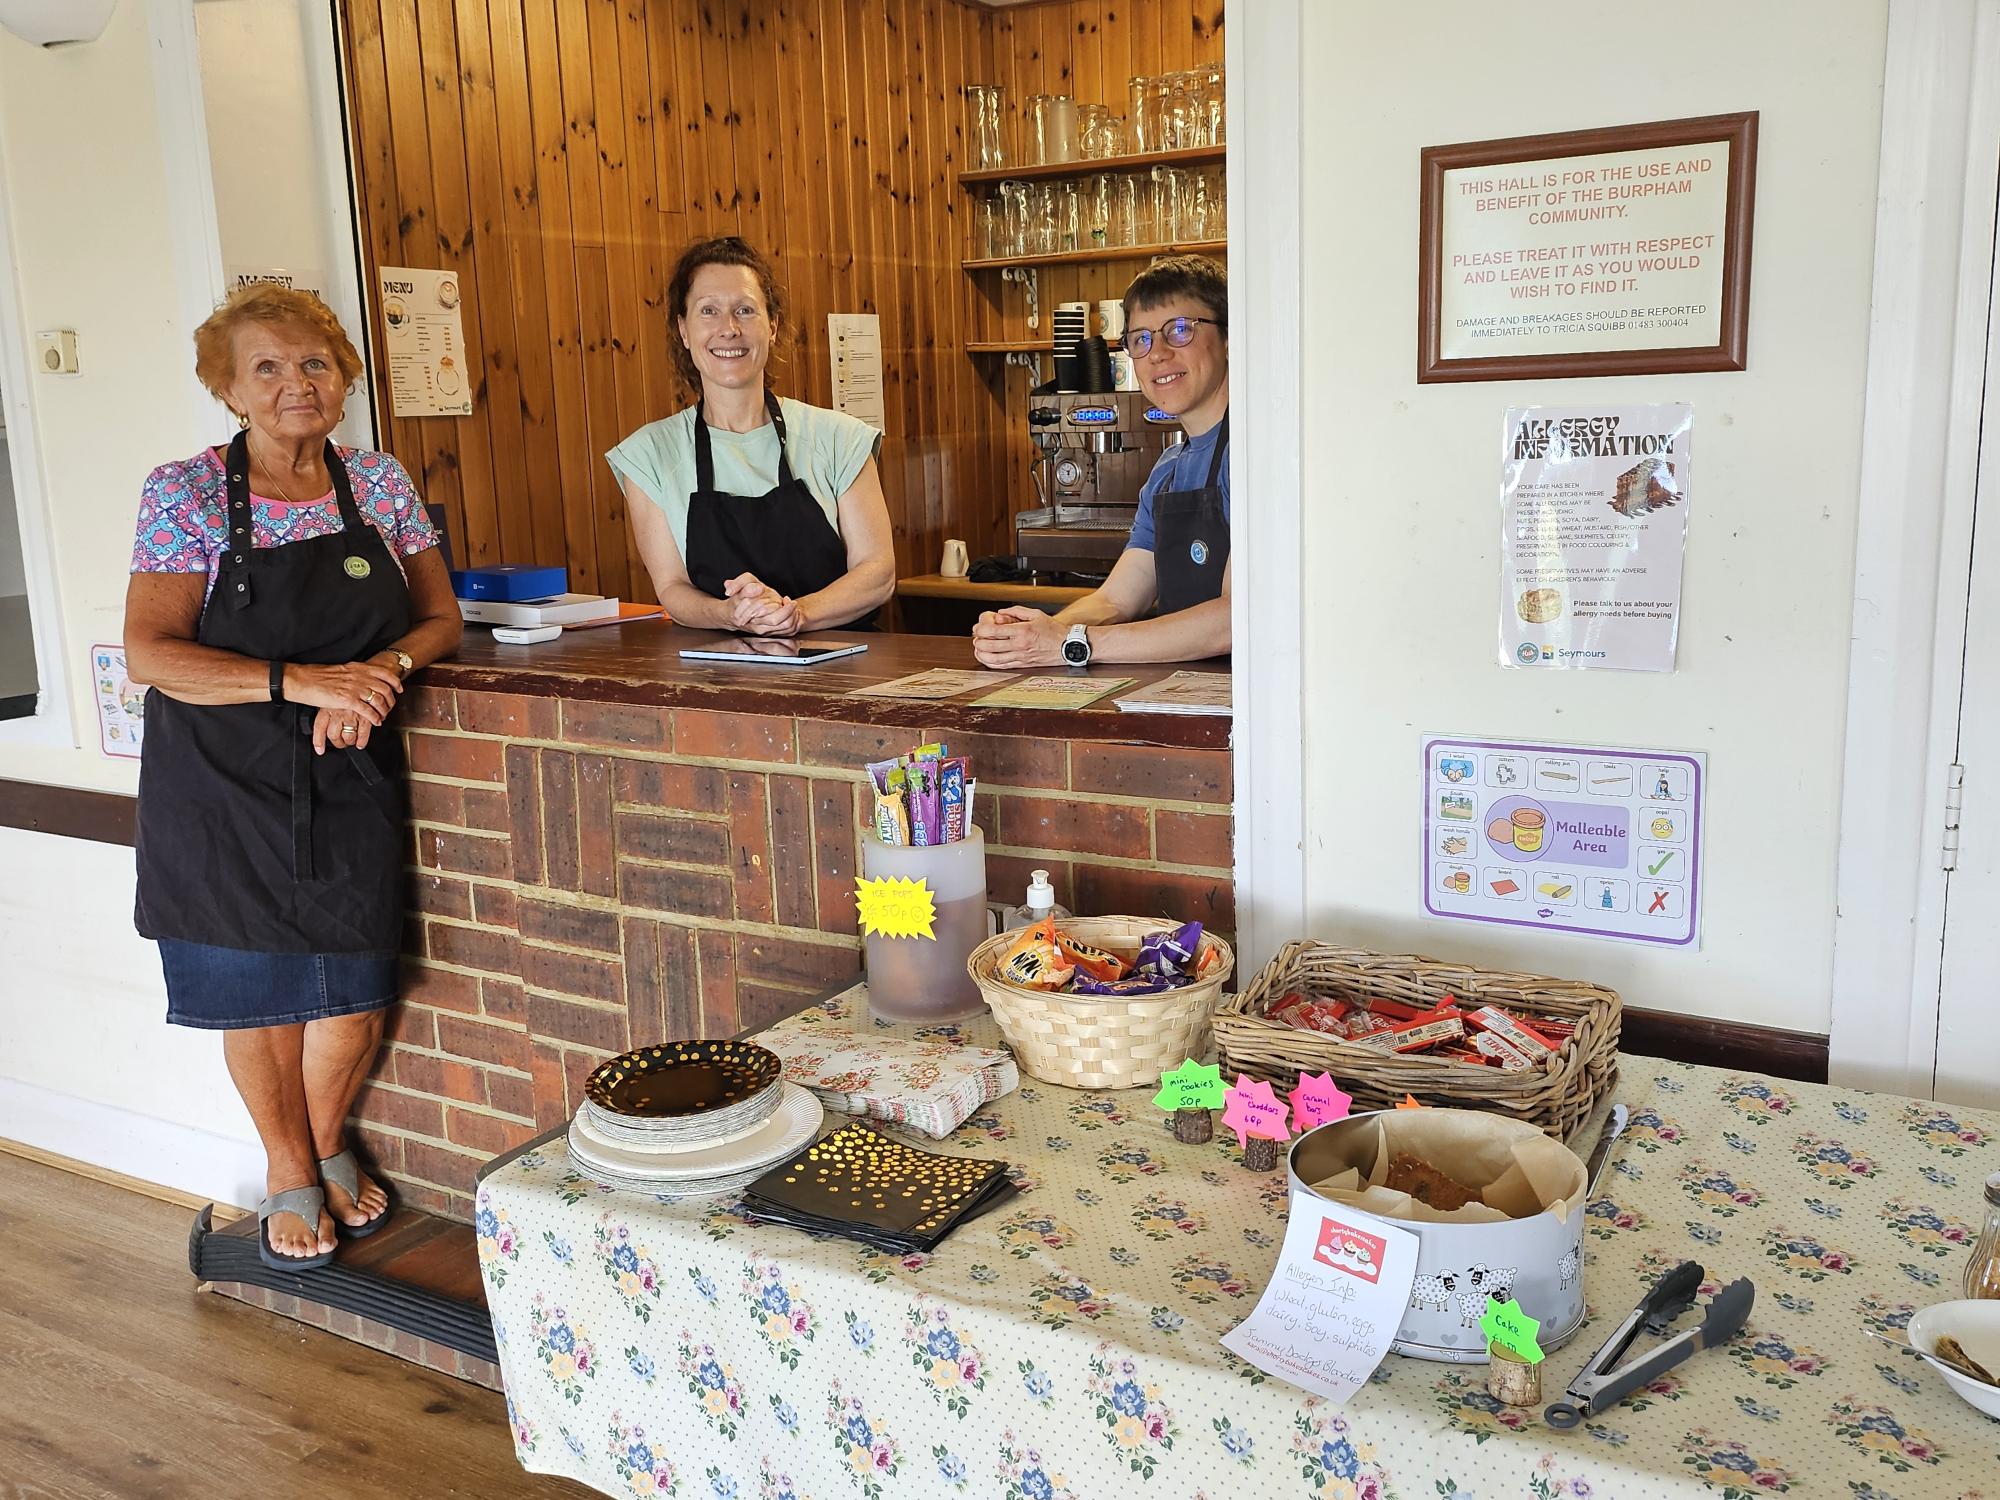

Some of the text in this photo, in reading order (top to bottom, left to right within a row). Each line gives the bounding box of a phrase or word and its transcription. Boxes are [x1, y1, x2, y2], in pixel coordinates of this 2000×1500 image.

[1460, 158, 1712, 196] THIS HALL IS FOR THE USE AND
[1476, 180, 1692, 212] BENEFIT OF THE BURPHAM
[1528, 205, 1628, 225] COMMUNITY.
[1453, 235, 1716, 267] PLEASE TREAT IT WITH RESPECT
[1463, 255, 1701, 285] AND LEAVE IT AS YOU WOULD
[383, 281, 414, 295] MENU
[1510, 278, 1639, 299] WISH TO FIND IT.
[1456, 304, 1707, 328] DAMAGE AND BREAKAGES SHOULD BE REPORTED
[1471, 318, 1689, 338] IMMEDIATELY TO TRICIA SQUIBB 01483 300404
[1514, 416, 1620, 440] ALLERGY
[1573, 600, 1598, 608] Please
[1599, 600, 1613, 608] talk
[1633, 600, 1655, 608] about
[1656, 601, 1673, 611] your
[1573, 610, 1598, 619] allergy
[1623, 610, 1646, 618] before
[1647, 611, 1673, 620] buying
[1558, 649, 1607, 659] Seymours
[1556, 821, 1627, 839] Malleable
[1572, 839, 1608, 854] Area
[872, 889, 886, 898] ICE
[1483, 1037, 1525, 1067] CARAMEL
[1170, 1075, 1188, 1087] mini
[1180, 1080, 1214, 1092] cookies
[1180, 1096, 1201, 1107] 50p
[1306, 1102, 1321, 1115] bars
[1495, 1314, 1520, 1337] Cake
